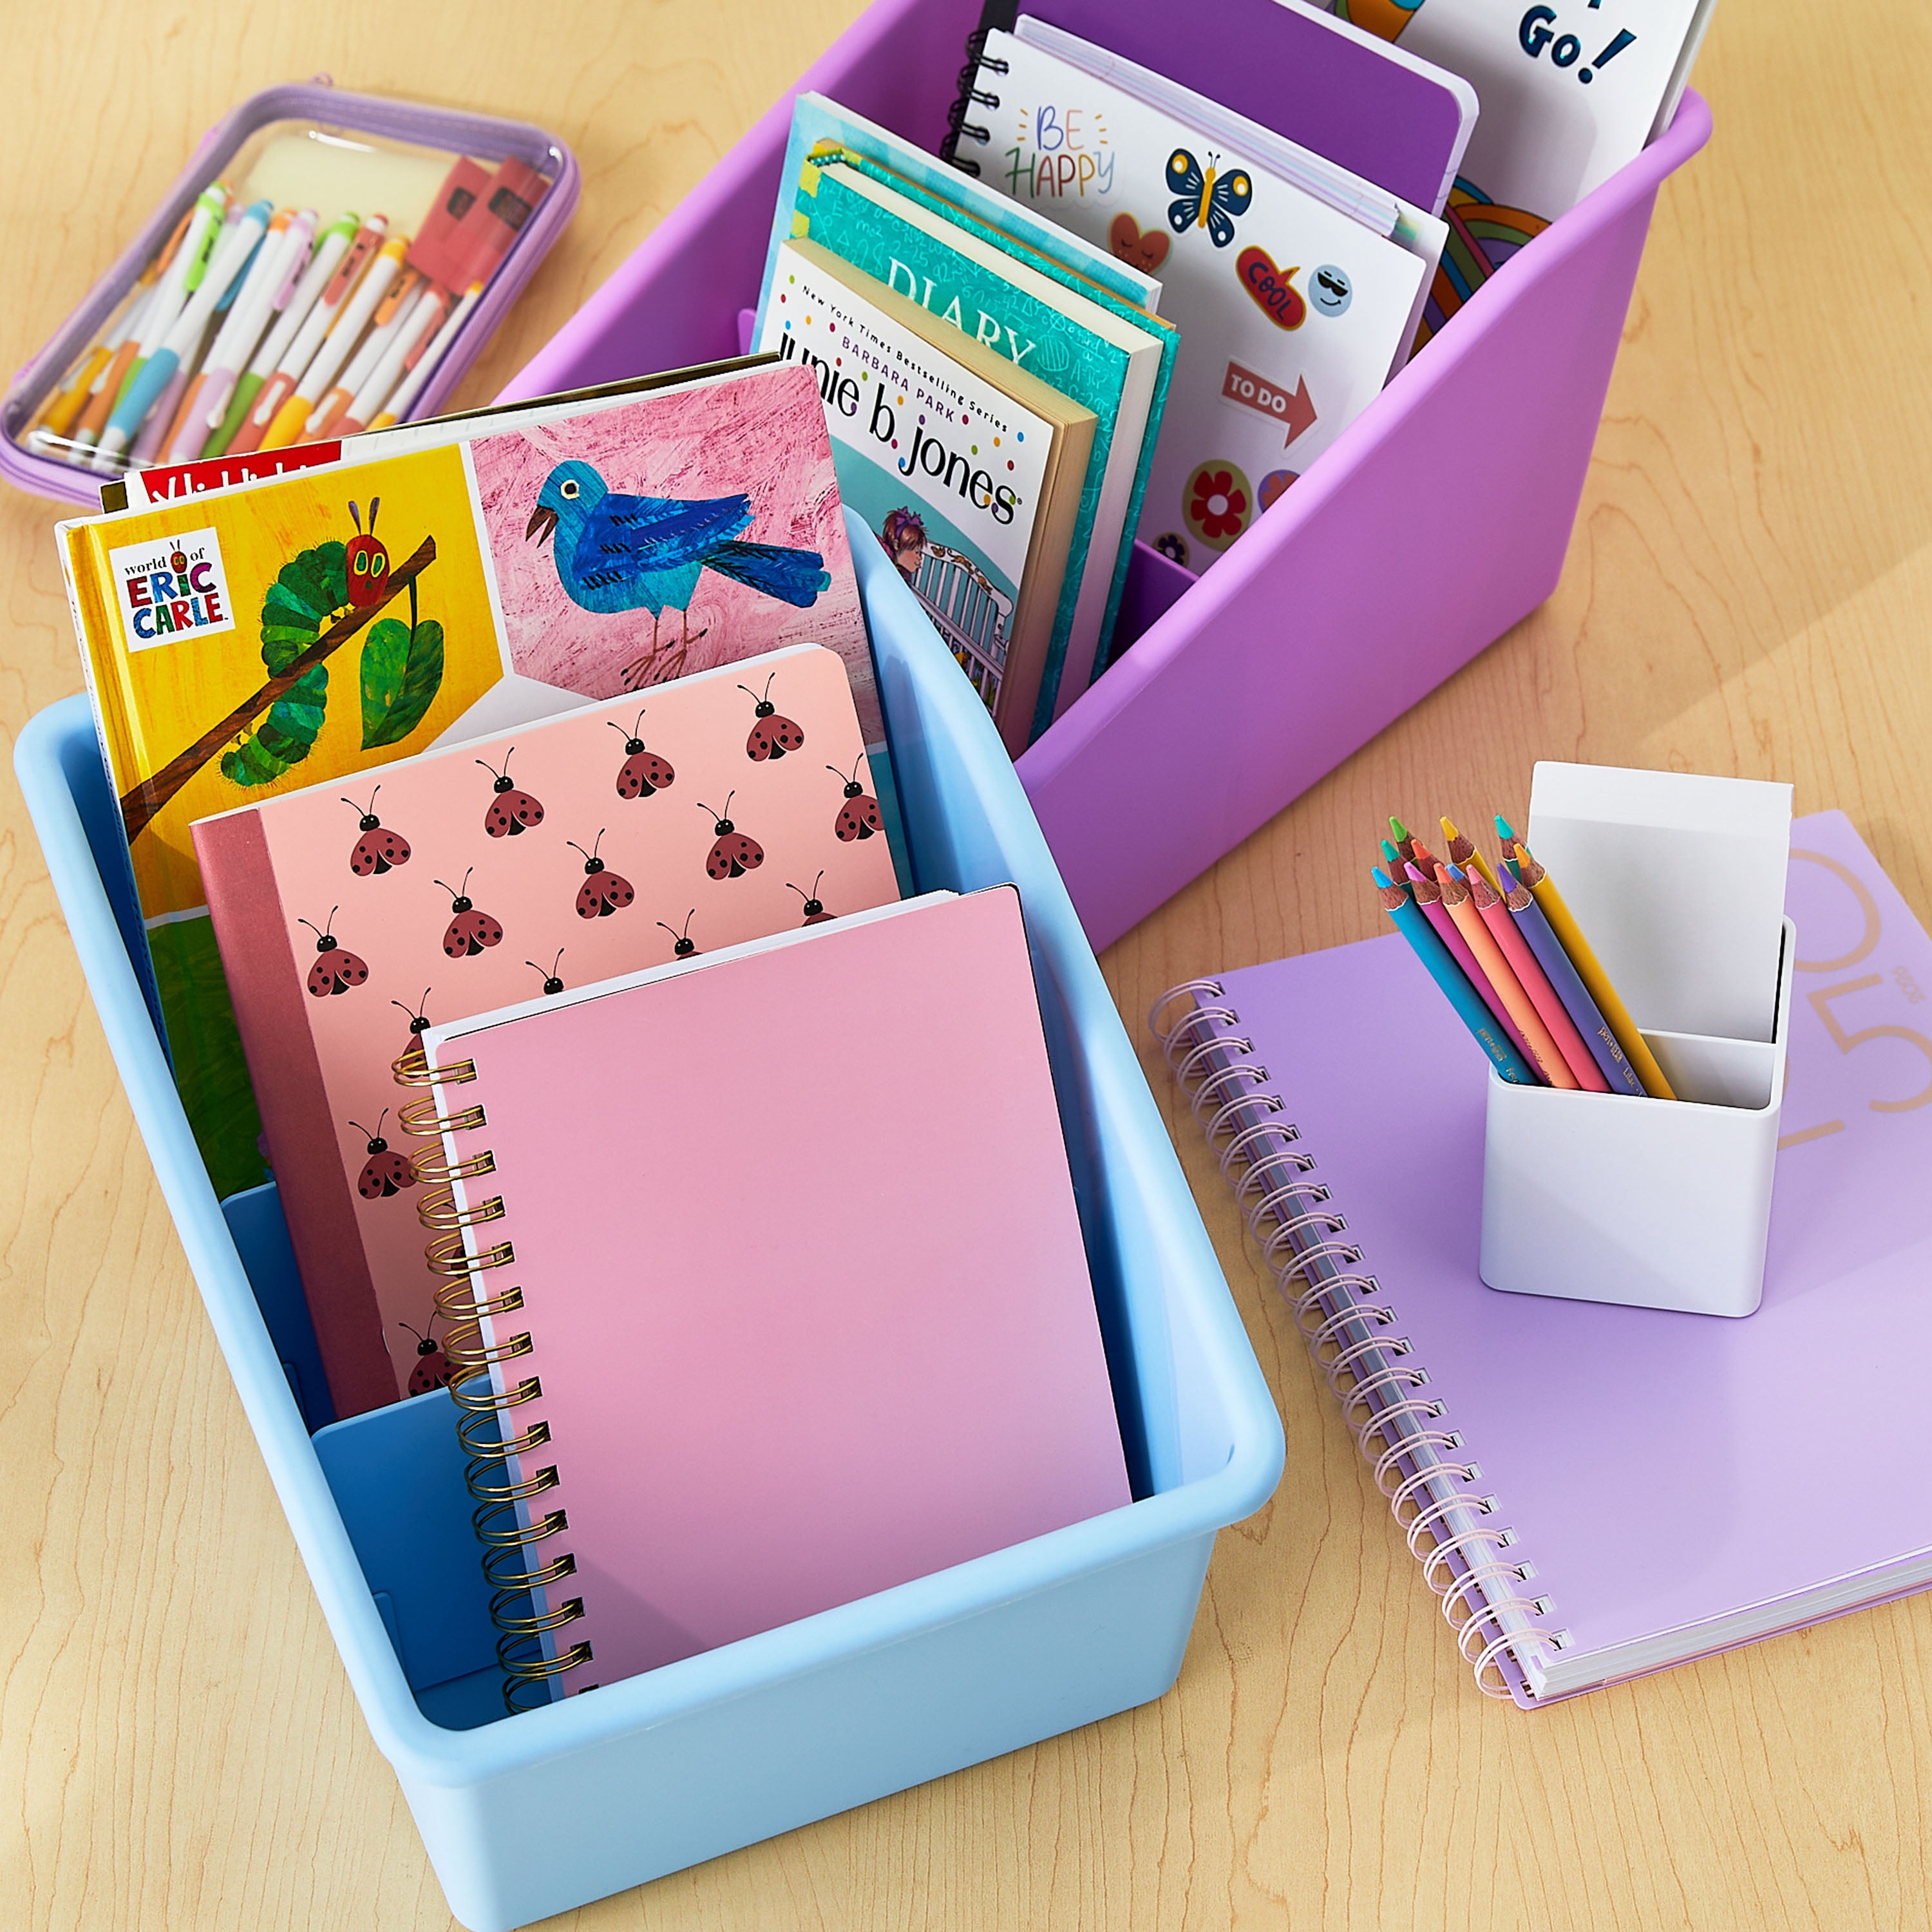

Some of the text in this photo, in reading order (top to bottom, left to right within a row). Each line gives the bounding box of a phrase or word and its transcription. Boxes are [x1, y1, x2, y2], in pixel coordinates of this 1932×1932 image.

[1519, 5, 1637, 84] Go!
[1036, 106, 1084, 151] BE
[1004, 146, 1115, 198] HAPPY
[888, 256, 1036, 365] DIARY
[1247, 261, 1291, 321] COOL
[802, 285, 1008, 432] New York Times Bestselling Series
[842, 336, 954, 422] BARBARA PARK
[1231, 374, 1287, 413] TO DO
[124, 547, 205, 576] world of
[133, 592, 224, 639] CARLE
